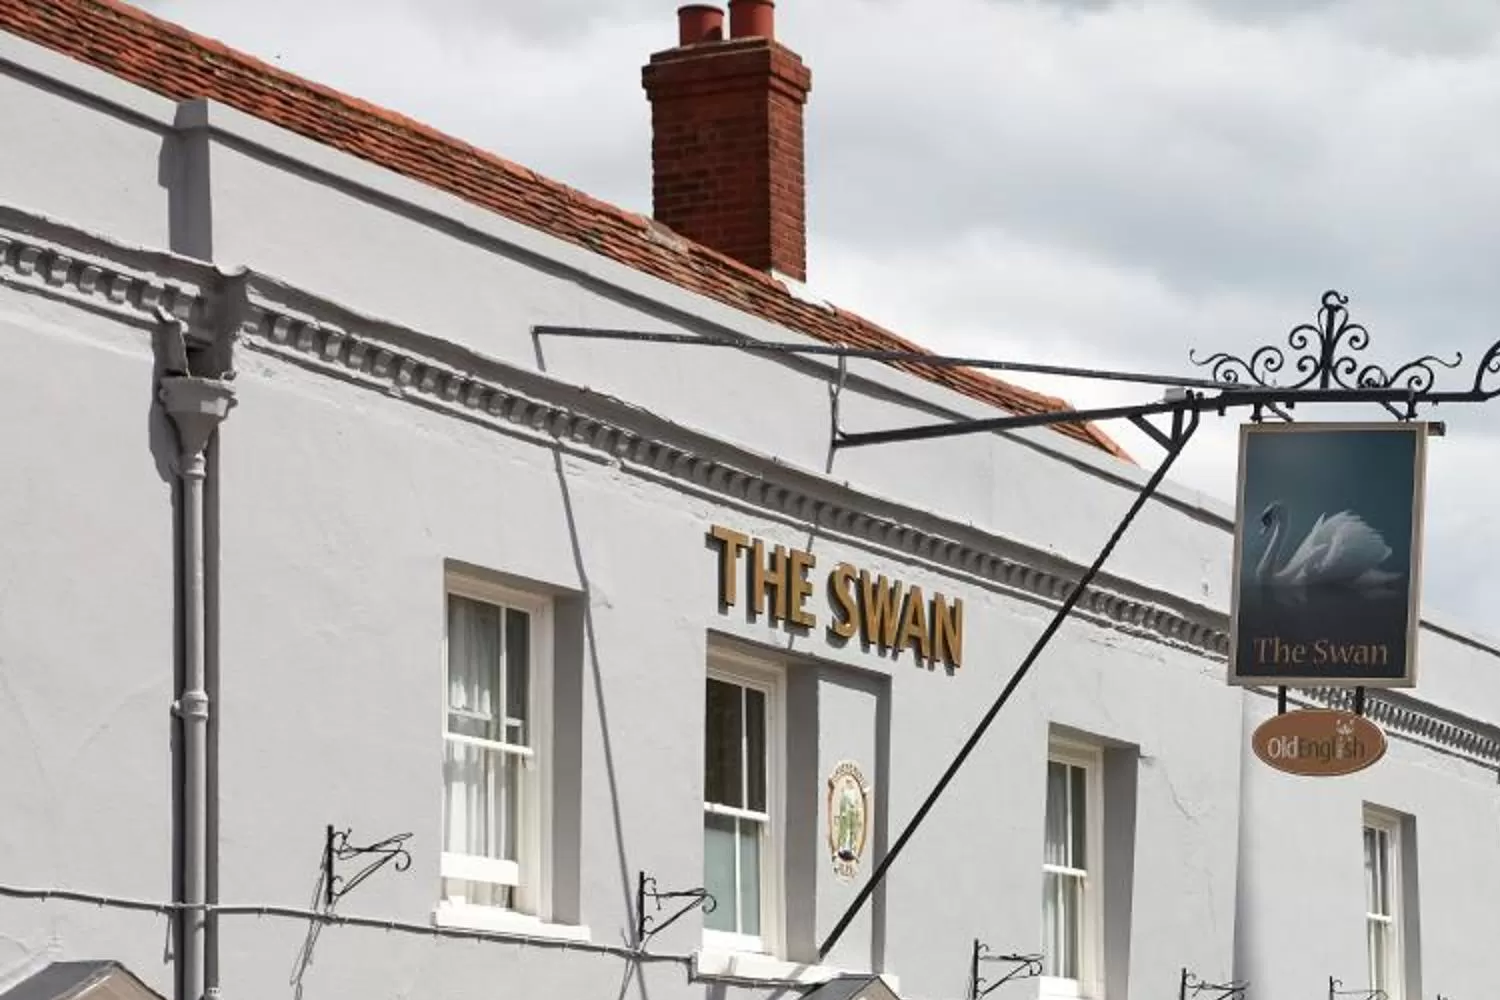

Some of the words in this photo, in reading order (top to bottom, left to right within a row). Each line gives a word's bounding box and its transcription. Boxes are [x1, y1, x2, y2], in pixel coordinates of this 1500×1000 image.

[710, 524, 817, 629] THE
[828, 561, 963, 668] SWAN
[1254, 636, 1306, 665] The
[1313, 637, 1389, 666] Swan
